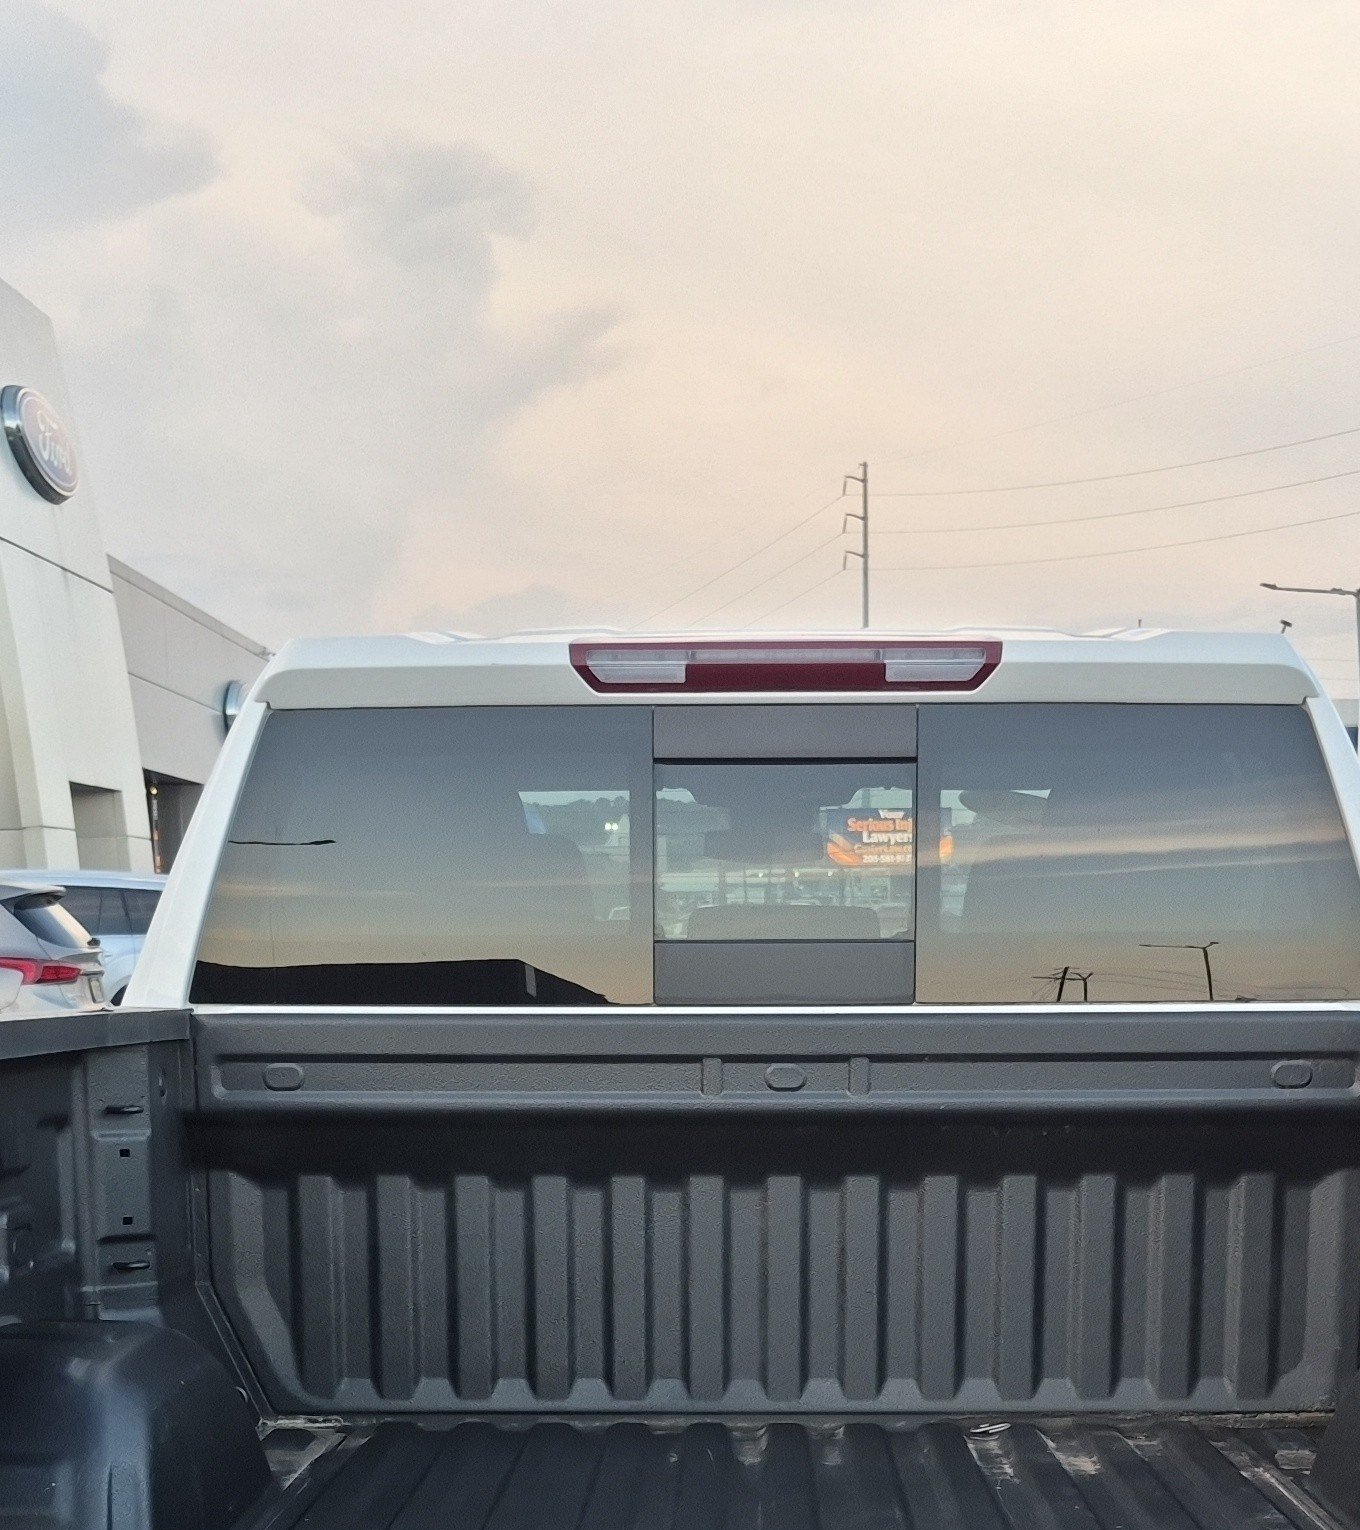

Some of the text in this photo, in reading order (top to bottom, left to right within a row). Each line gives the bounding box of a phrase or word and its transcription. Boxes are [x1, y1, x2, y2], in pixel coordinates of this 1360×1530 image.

[37, 409, 73, 476] Ford
[847, 817, 913, 832] Serious Inj
